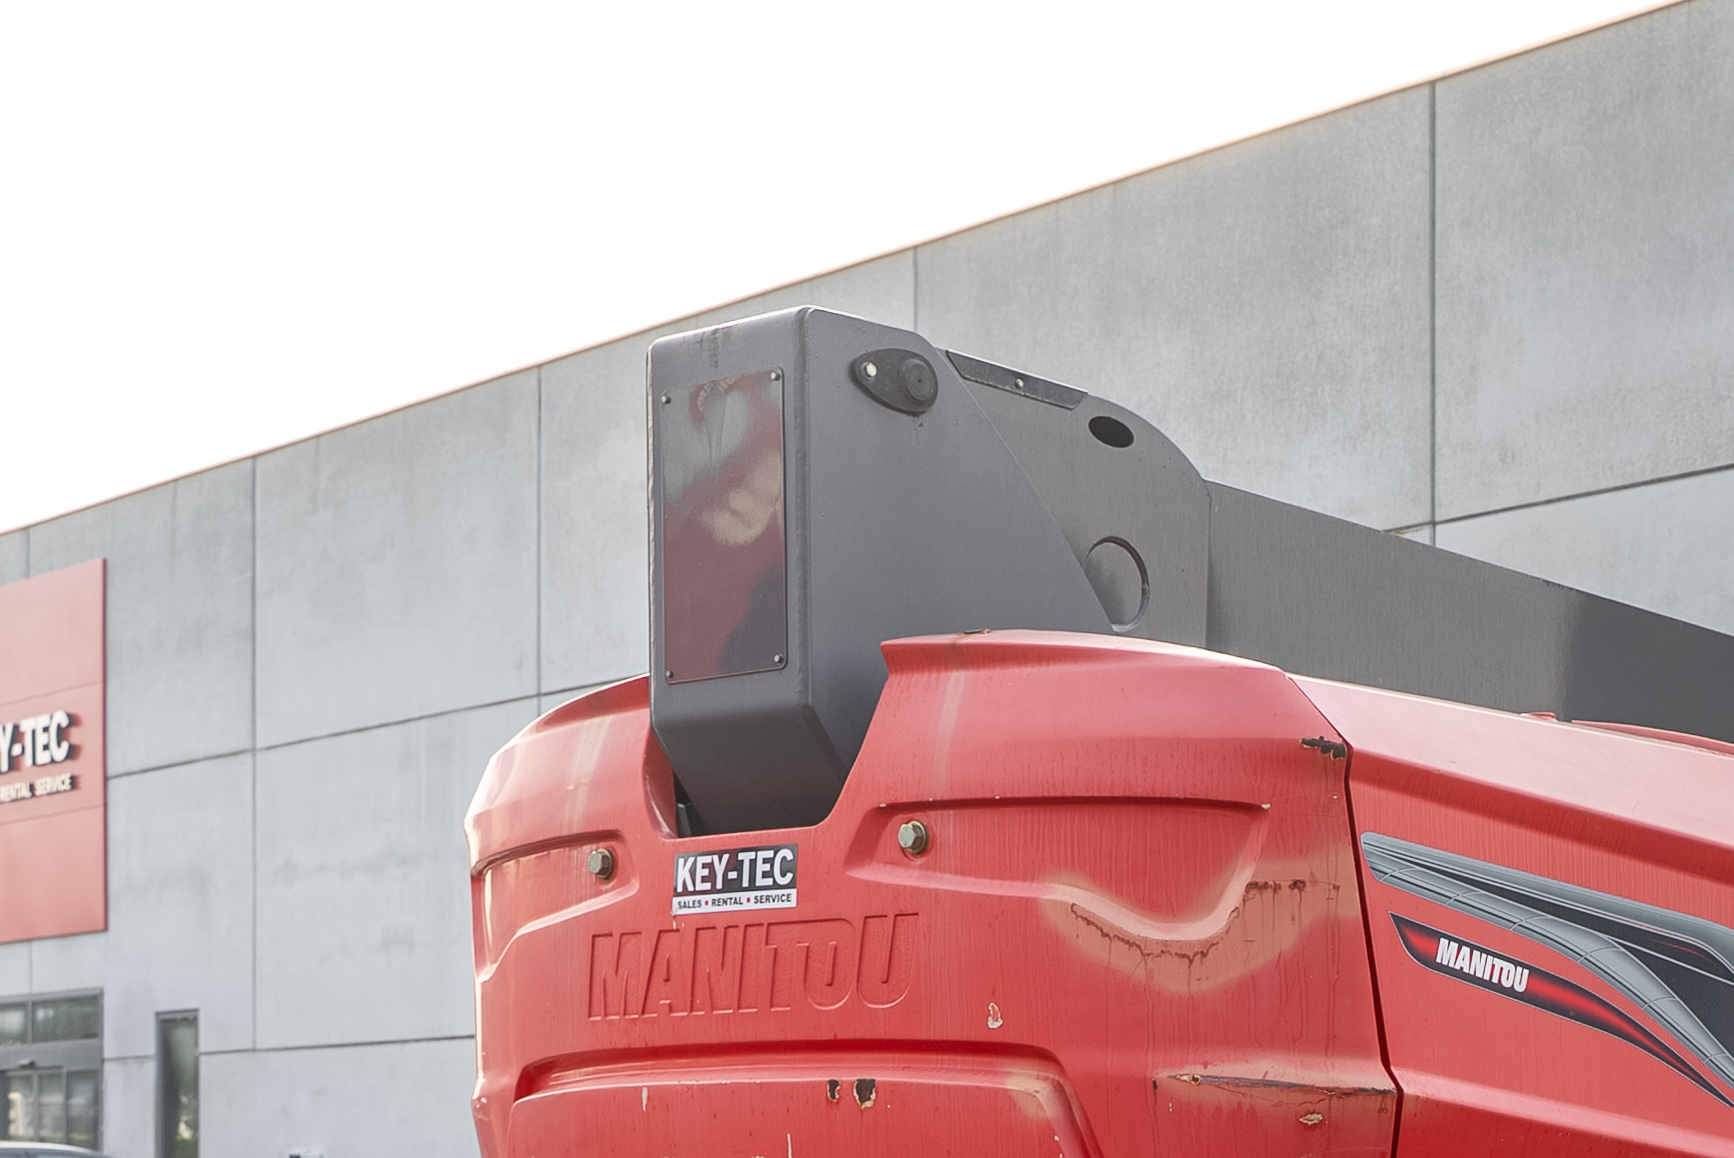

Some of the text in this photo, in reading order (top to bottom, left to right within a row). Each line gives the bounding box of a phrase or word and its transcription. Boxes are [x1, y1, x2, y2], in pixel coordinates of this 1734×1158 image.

[0, 709, 70, 773] Y-TEC
[34, 772, 72, 797] SERVICE
[676, 848, 794, 893] KEY-TEC
[677, 893, 792, 910] SALES RENTAL SERVICE
[588, 912, 919, 1021] MANITOU
[1435, 937, 1530, 993] MANITOU
